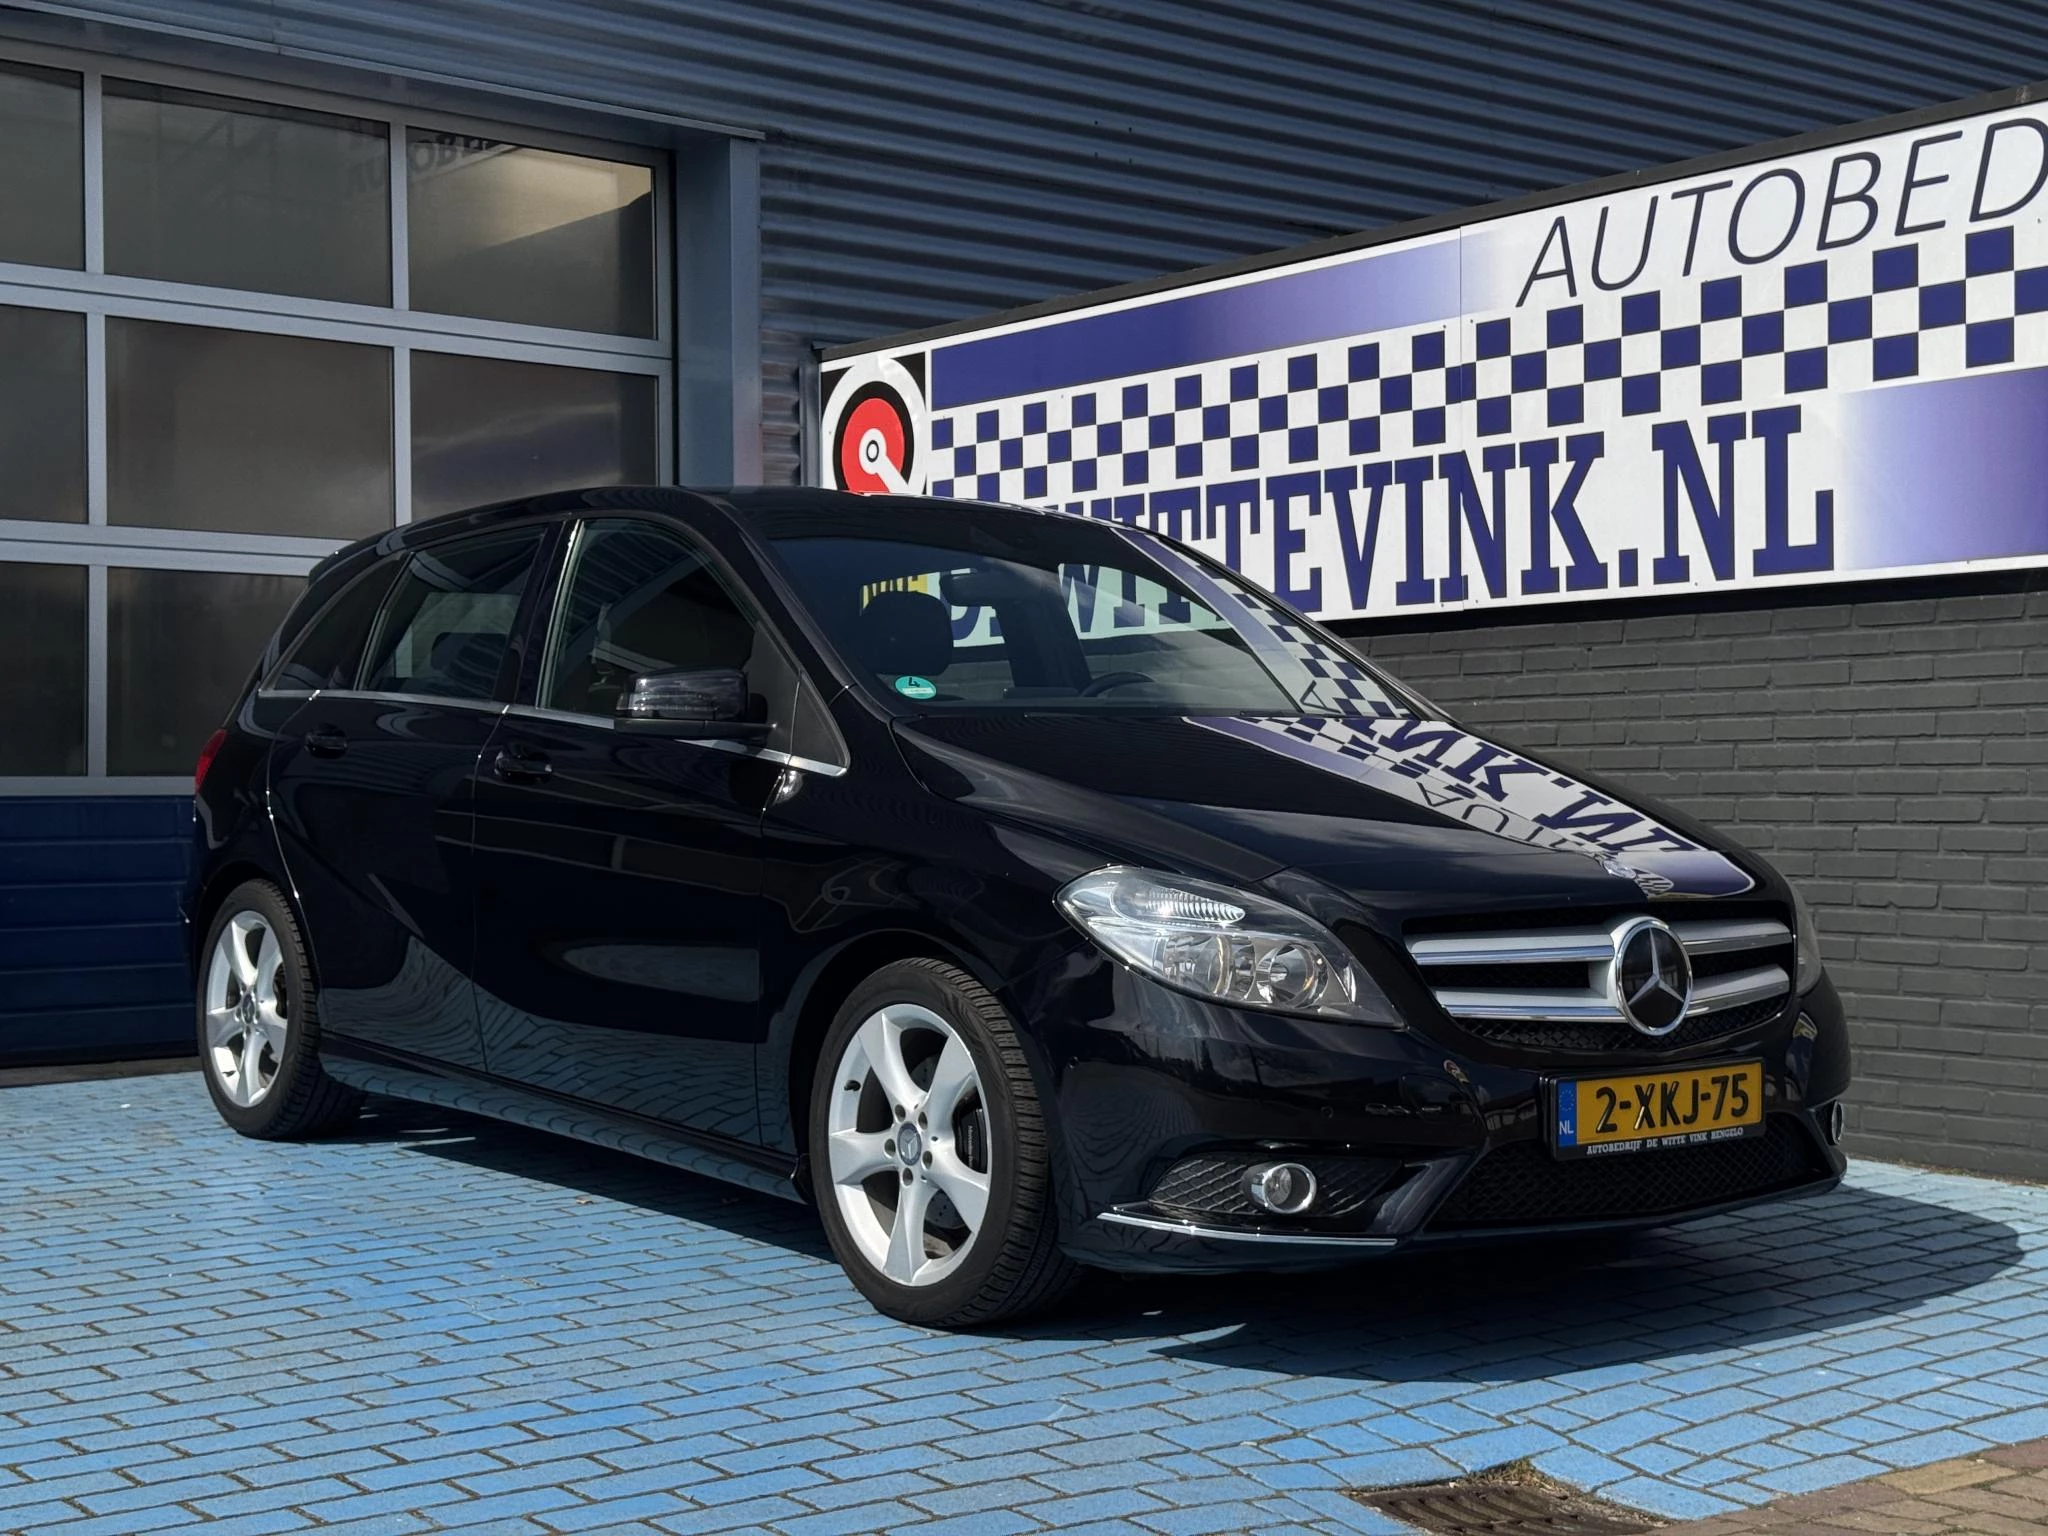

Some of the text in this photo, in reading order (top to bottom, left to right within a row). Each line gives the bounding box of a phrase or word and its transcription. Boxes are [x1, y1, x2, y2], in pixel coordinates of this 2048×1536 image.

[1515, 116, 2048, 307] AUTOBED
[1596, 1073, 1749, 1133] 2-XKJ-75
[1559, 1120, 1574, 1135] NL
[1586, 1127, 1744, 1155] AUTOBEDRIJF DE WITTE VINK HENGELO
